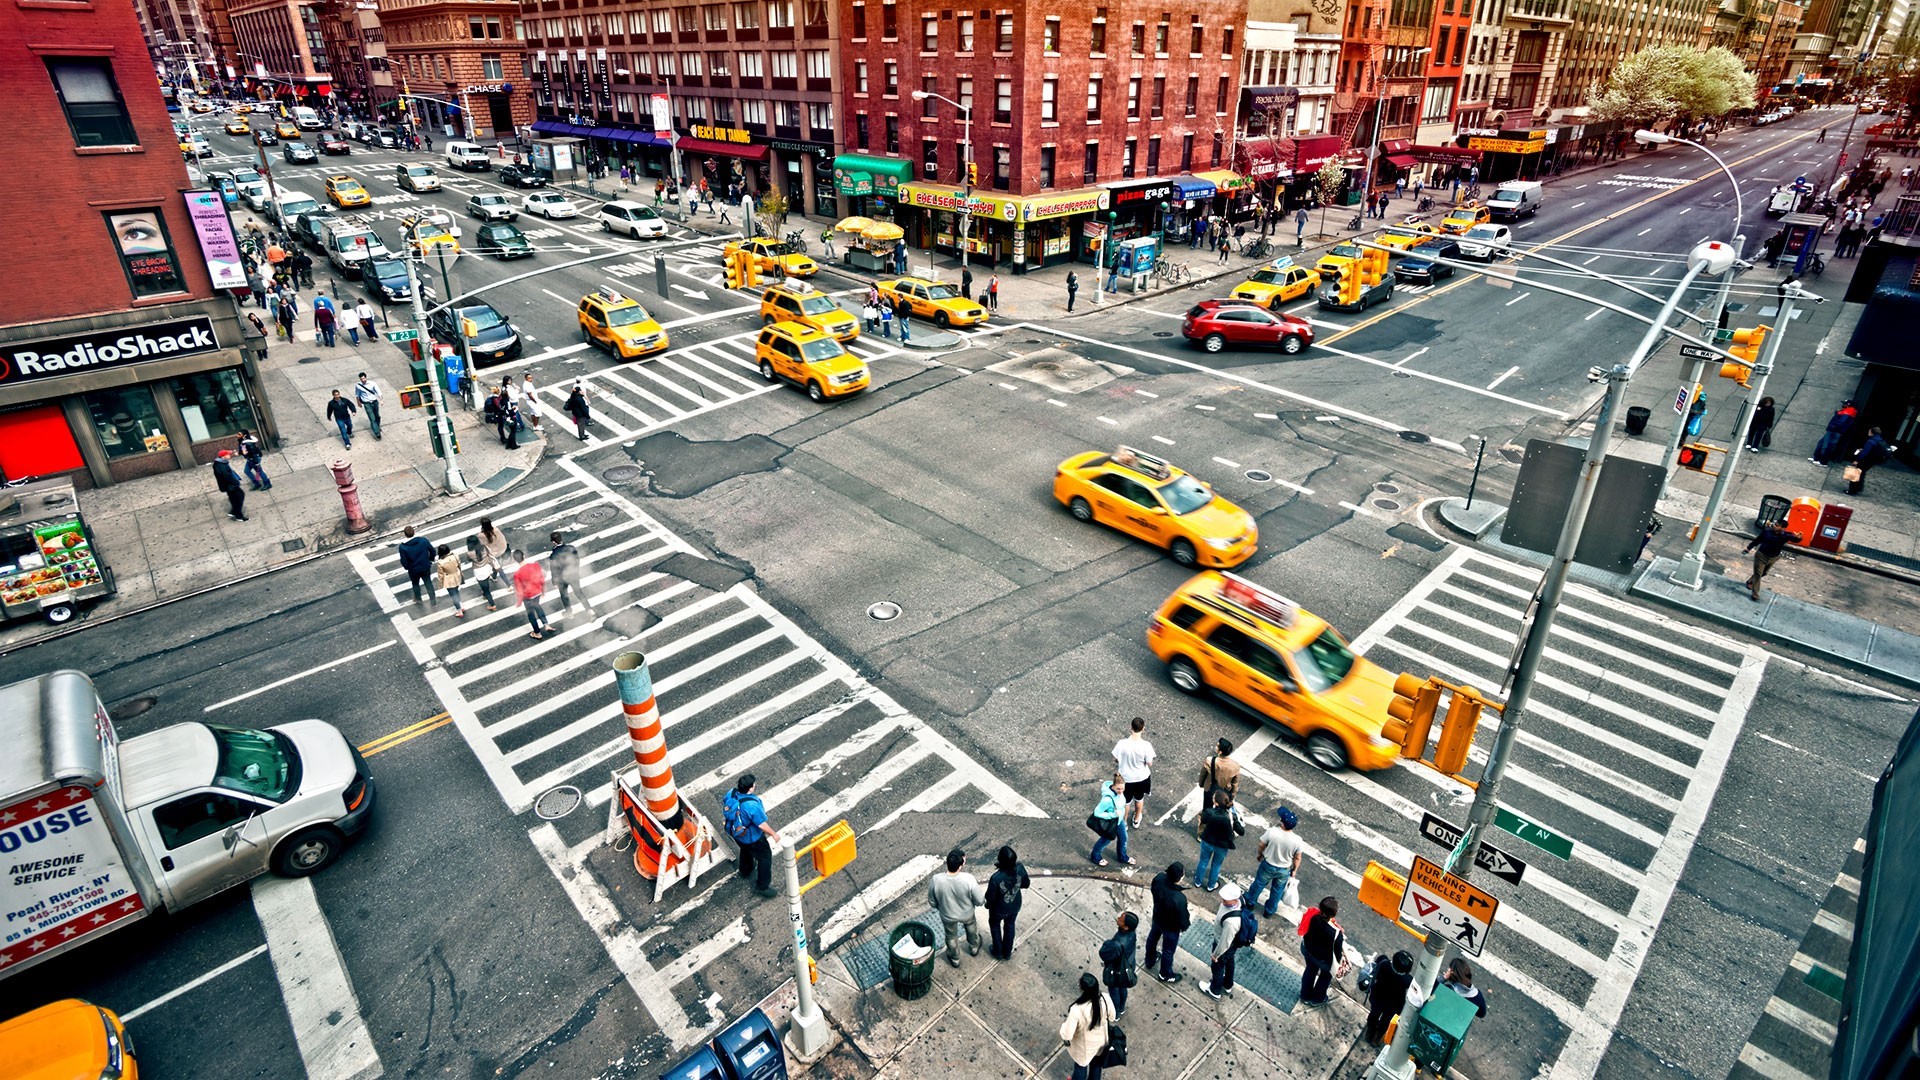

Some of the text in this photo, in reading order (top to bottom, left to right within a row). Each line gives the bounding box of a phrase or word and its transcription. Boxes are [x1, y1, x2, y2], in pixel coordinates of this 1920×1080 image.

[467, 84, 502, 94] CHASE
[568, 113, 596, 127] FedEx Office
[697, 125, 714, 139] BEACH
[727, 128, 751, 144] TANNING
[916, 193, 956, 208] CHELSEA
[1037, 199, 1097, 216] CHELSEA PAPAYA
[130, 257, 167, 268] EYE BROW
[132, 265, 173, 276] THREADING
[390, 333, 397, 341] W
[400, 331, 410, 340] 23
[1725, 331, 1730, 339] 7
[13, 326, 214, 376] RadioShack
[1700, 350, 1714, 358] WAY
[0, 804, 93, 854] OUSE
[1515, 818, 1551, 841] 7 AV
[1434, 827, 1508, 871] ONE WAY
[9, 853, 85, 875] AWESOME
[13, 866, 77, 886] SERVICE
[1419, 861, 1467, 893] TURNING
[6, 873, 111, 922] Pearl River, NY
[1417, 873, 1463, 903] VEHICLES
[28, 887, 105, 923] 845-735-1508
[6, 888, 129, 943] 85 N. MIDDLETOWN RD.
[1438, 912, 1451, 926] TO
